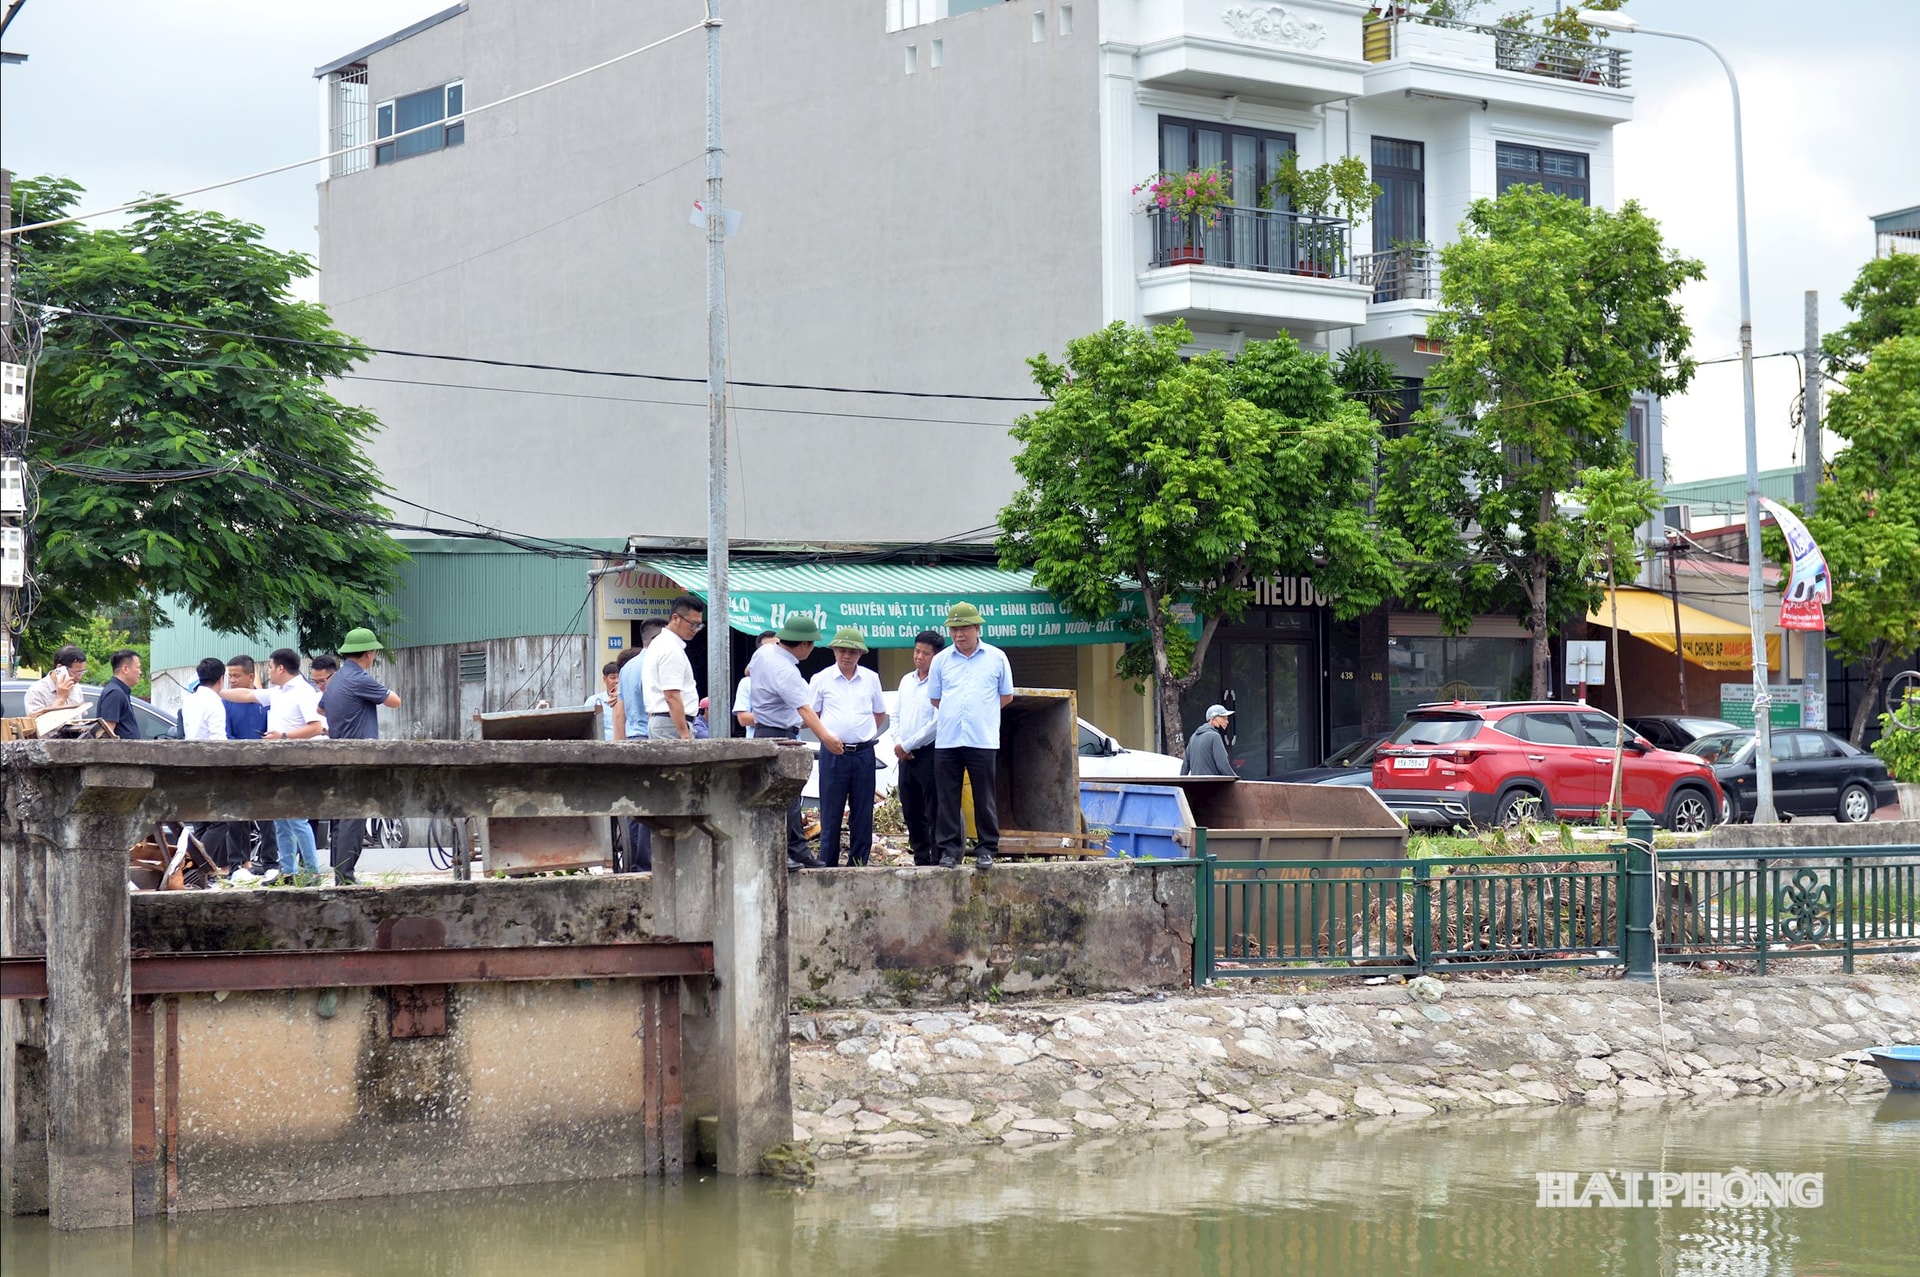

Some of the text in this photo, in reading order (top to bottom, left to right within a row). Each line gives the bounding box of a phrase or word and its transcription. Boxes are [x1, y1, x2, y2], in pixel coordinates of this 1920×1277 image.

[840, 601, 885, 616] CHUYÊN
[888, 602, 907, 618] VẬT
[1030, 602, 1055, 615] BƠM
[871, 621, 893, 637] BÓN
[898, 621, 920, 637] CÁC
[988, 624, 1017, 640] DỤNG
[1020, 623, 1035, 639] CỤ
[1038, 621, 1061, 636] LÀM
[1340, 671, 1354, 680] 438
